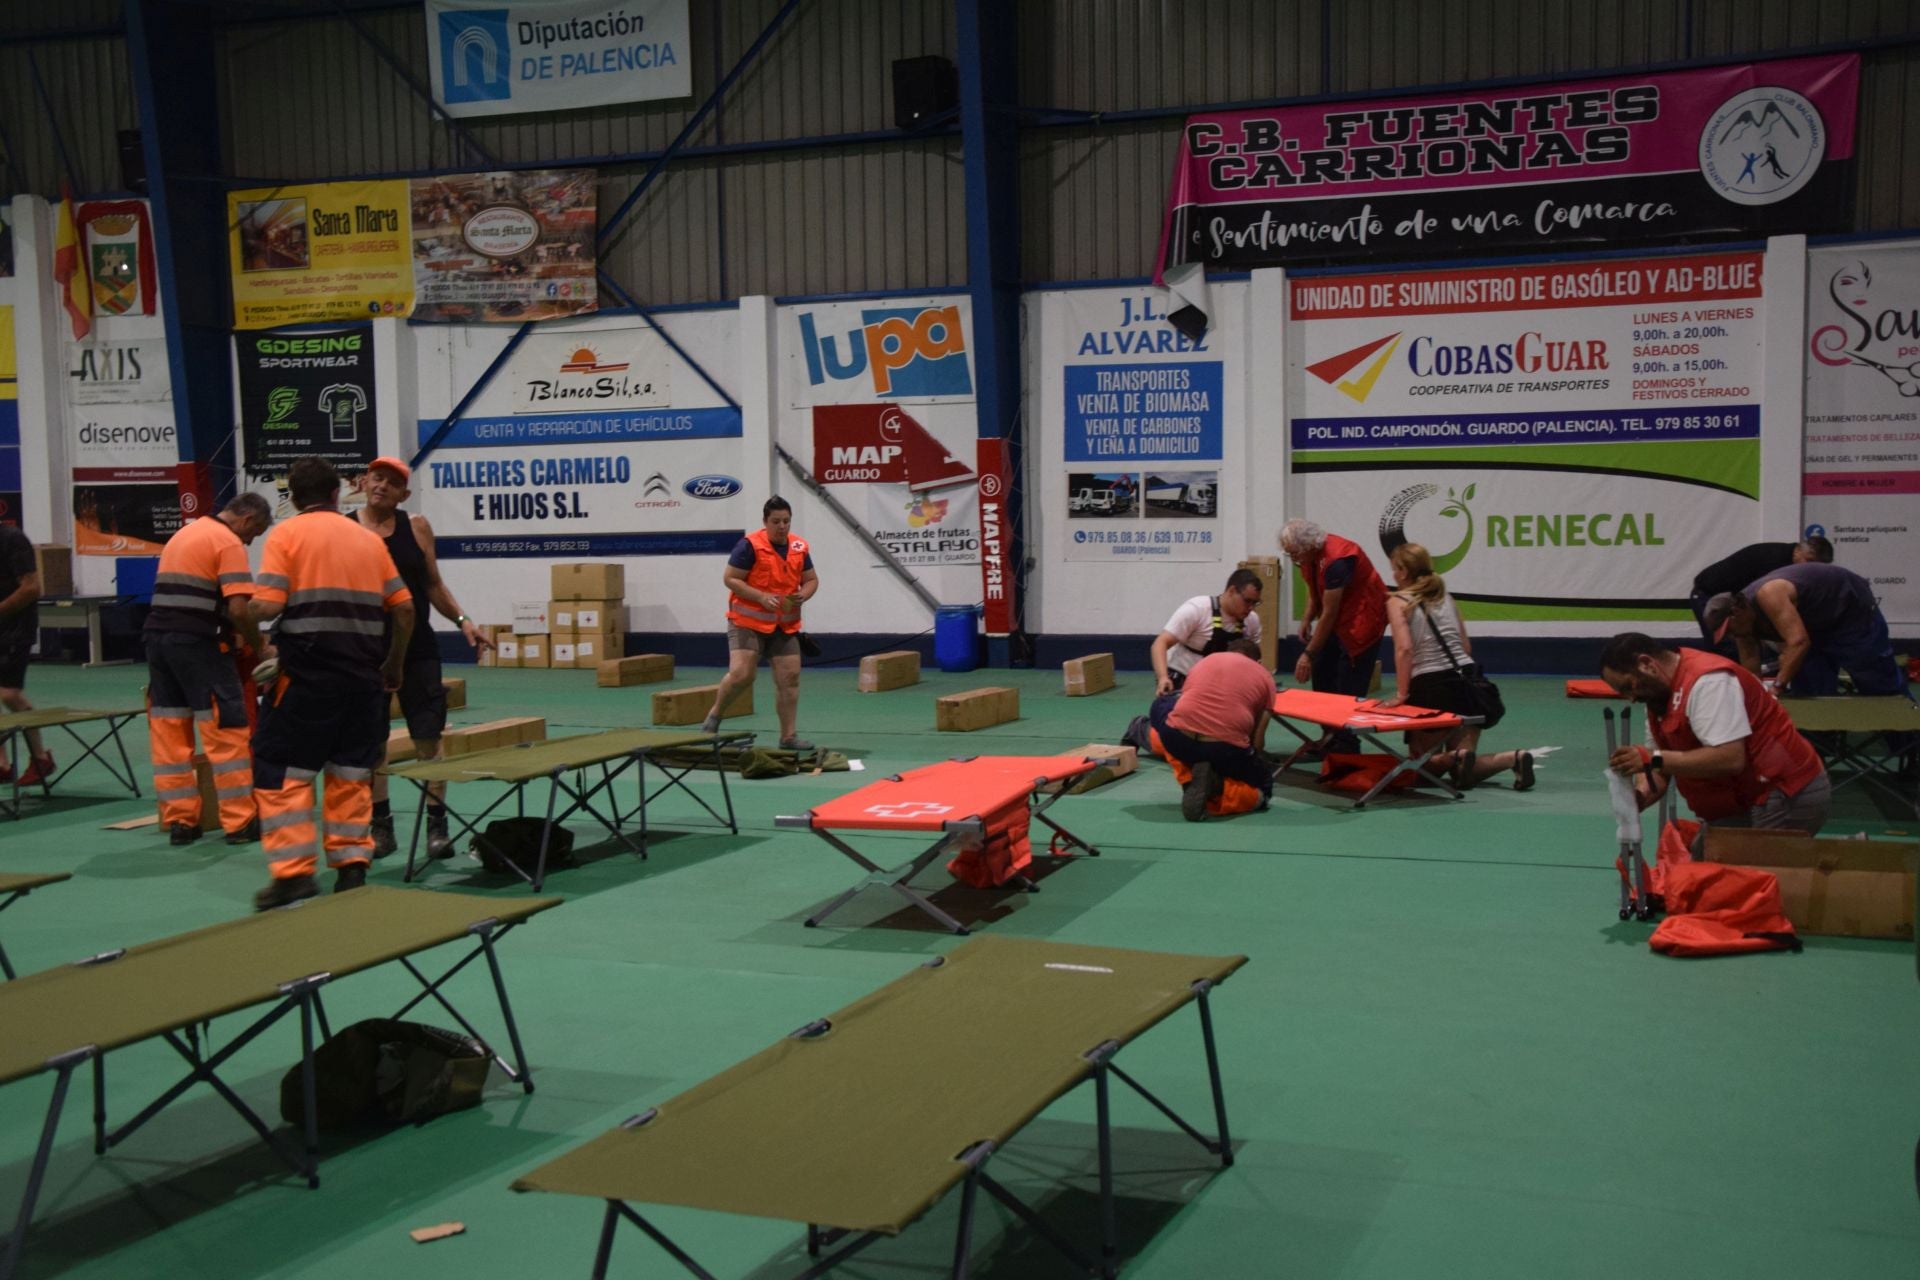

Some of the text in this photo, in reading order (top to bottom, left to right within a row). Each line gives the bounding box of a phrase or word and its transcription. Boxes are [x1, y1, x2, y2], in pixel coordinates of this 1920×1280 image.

[517, 10, 645, 49] Diputación
[521, 42, 677, 81] DE PALENCIA
[1187, 85, 1660, 157] C.B. FUENTES
[1208, 123, 1631, 191] CARRIONAS
[312, 205, 398, 236] Santa Marta
[1209, 204, 1384, 258] Sentimiento
[1395, 209, 1438, 240] de
[1451, 209, 1522, 234] una
[1535, 199, 1677, 235] Comarca
[1296, 262, 1756, 311] UNIDAD DE SUMINISTRO DE GASÓLEO Y AD-BLUE
[1120, 297, 1166, 327] J.L.
[1633, 308, 1754, 325] LUNES A VIERNES
[256, 335, 362, 354] GDESING
[1078, 328, 1210, 355] ALVAREZ
[1633, 326, 1729, 341] 9,00h. a 20,00h.
[798, 305, 966, 394] lupa
[1633, 343, 1700, 357] SÁBADOS
[74, 347, 141, 381] AXIS
[259, 355, 358, 368] SPORTWEAR
[1633, 359, 1728, 374] 9,00h. a 15,00h.
[1096, 369, 1190, 391] TRANSPORTES
[1409, 379, 1610, 396] COOPERATIVA DE TRANSPORTES
[1632, 377, 1707, 390] DOMINGOS Y
[1078, 391, 1210, 414] VENTA DE BIOMASA
[1632, 387, 1750, 400] FESTIVOS CERRADO
[475, 415, 693, 438] VENTA Y REPARACIÓN DE VEHÍCULOS
[1086, 416, 1201, 436] VENTA DE CARBONES
[1308, 415, 1740, 439] POL. IND. CAMPONDÓN. GUARDO (PALENCIA). TEL. 979 85 30 61
[1806, 413, 1917, 424] TRATAMIENTOS CAPILARES
[79, 422, 175, 444] disenove
[1807, 433, 1868, 442] TRATAMIENTOS
[1870, 433, 1881, 441] DE
[1086, 434, 1200, 455] Y LEÑA A DOMICILIO
[1826, 455, 1836, 463] DE
[1861, 454, 1918, 462] PERMANENTES
[430, 455, 631, 489] TALLERES CARMELO
[825, 468, 880, 481] GUARDO
[694, 477, 731, 496] Ford
[473, 492, 588, 520] E HIJOS S.L.
[874, 527, 971, 541] Almacén de frutas
[1487, 512, 1665, 548] RENECAL
[982, 503, 1004, 600] MAPFRE
[1874, 577, 1907, 585] GUARDO
